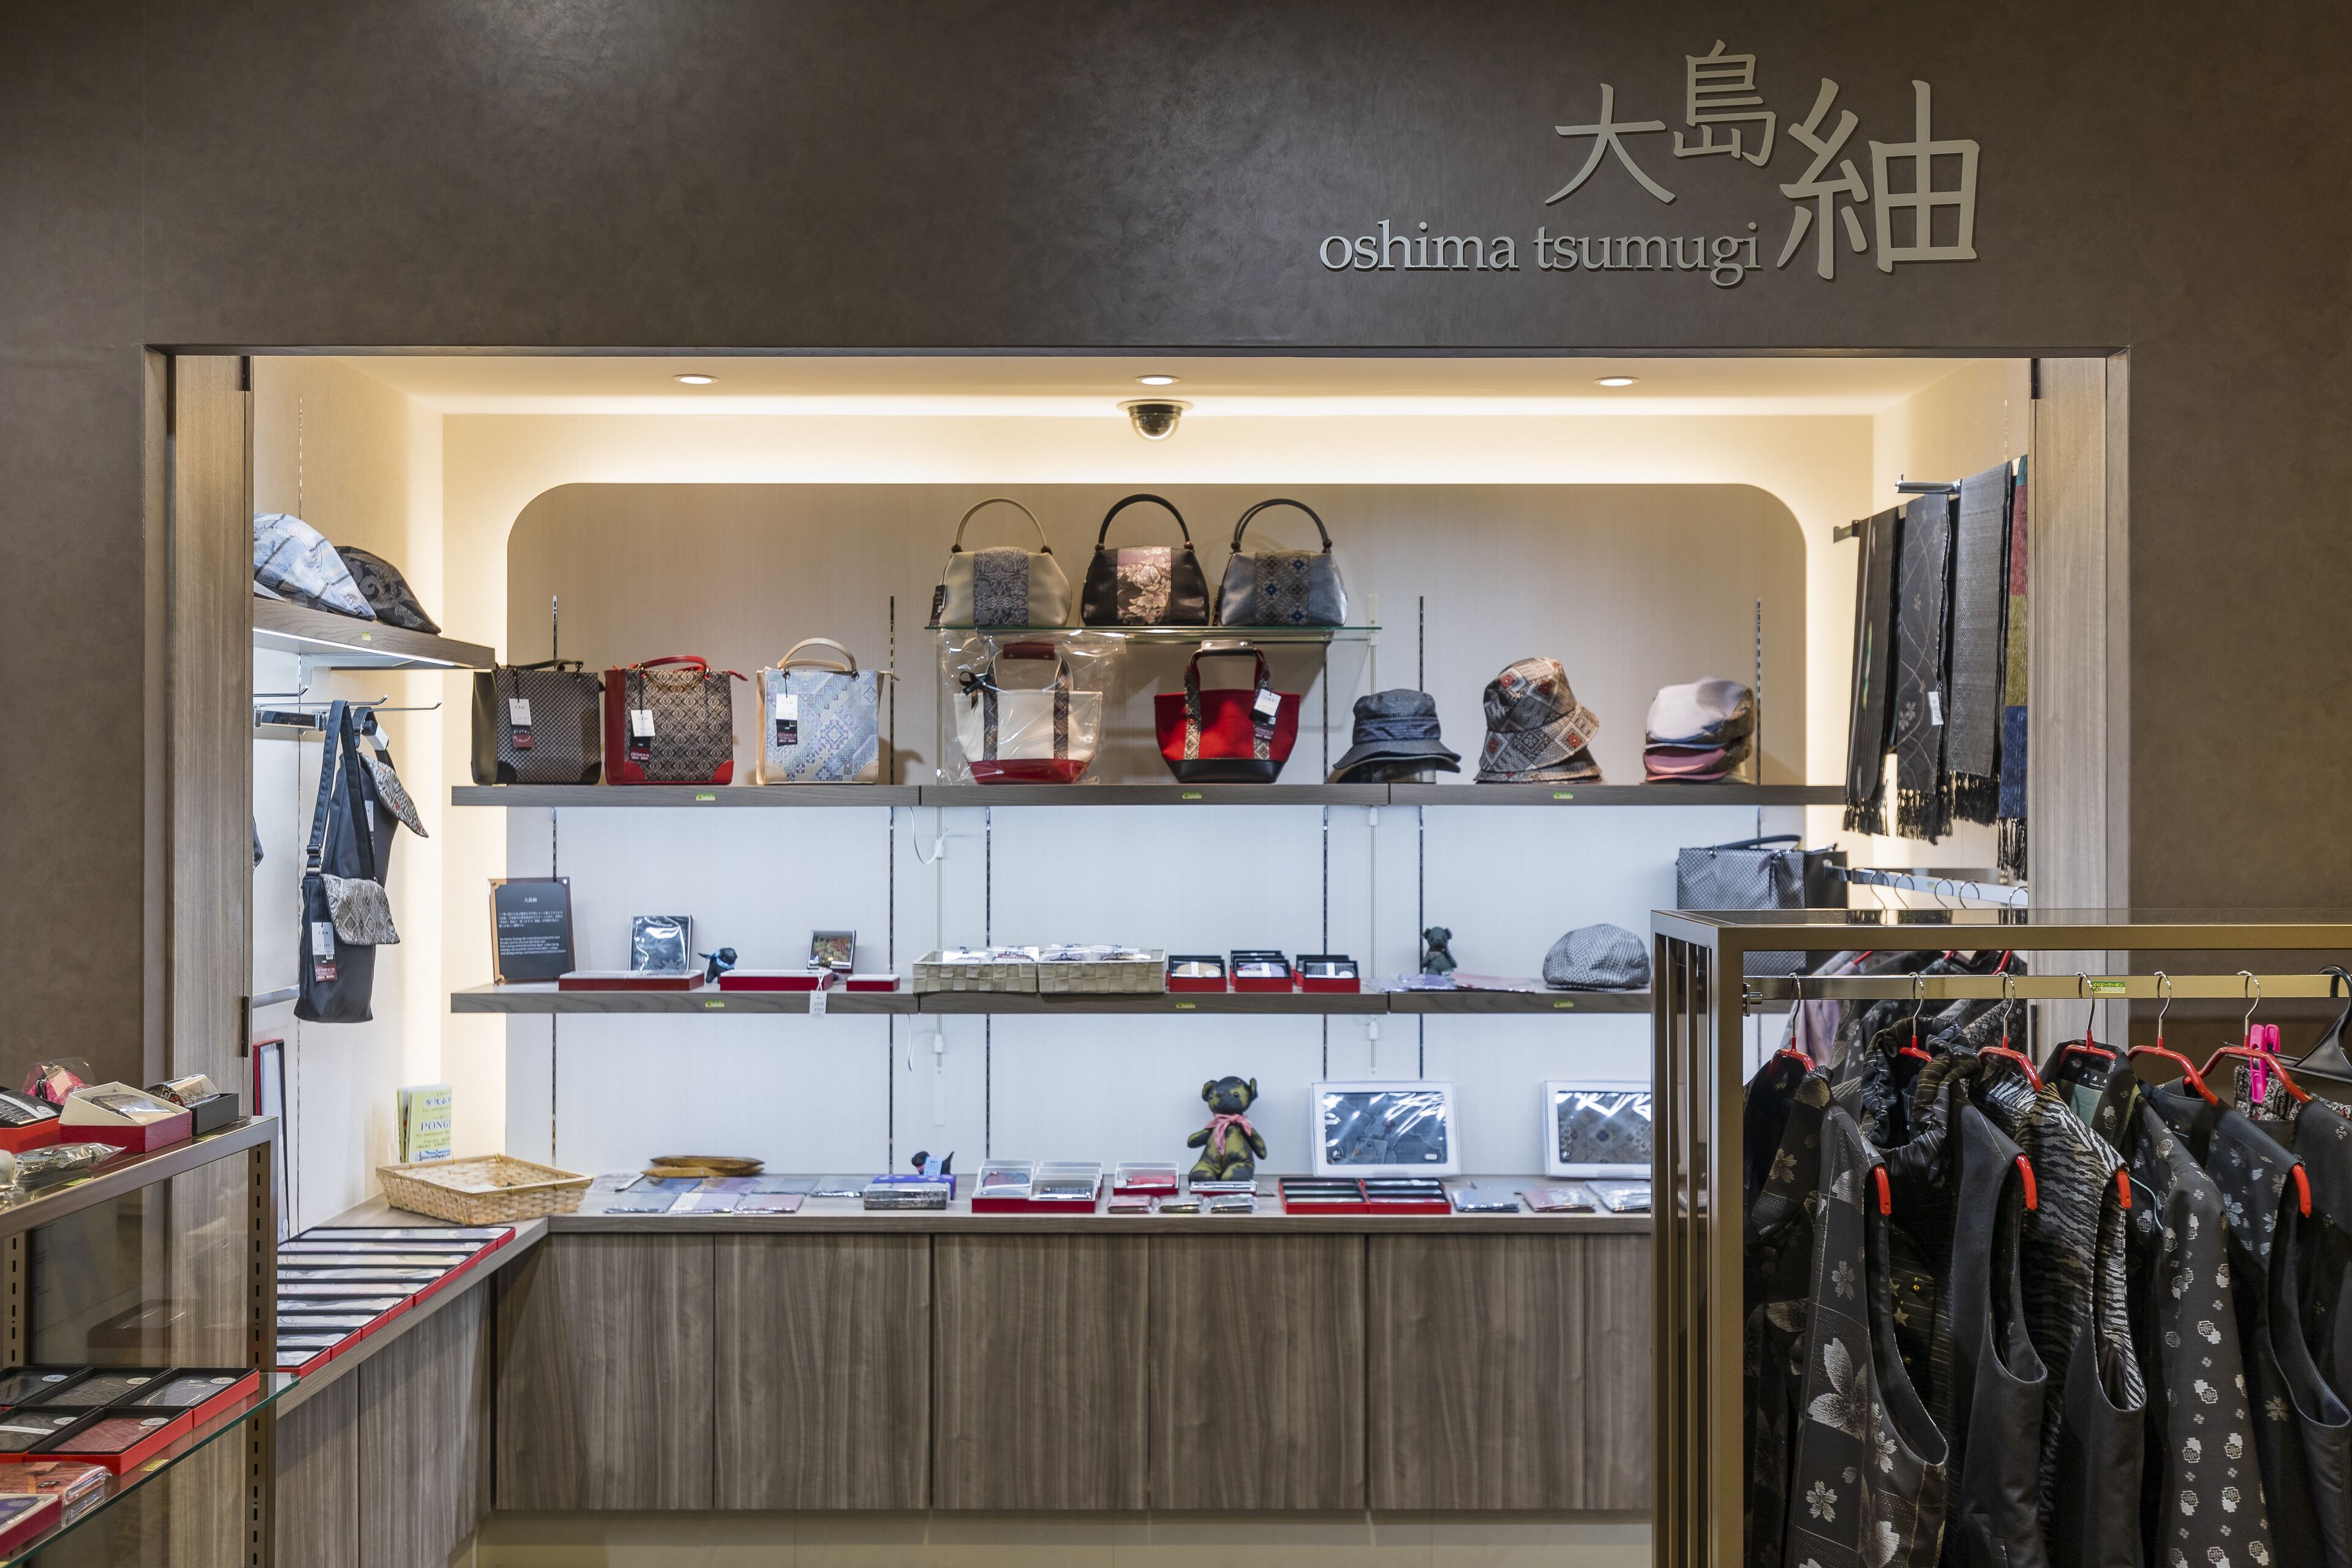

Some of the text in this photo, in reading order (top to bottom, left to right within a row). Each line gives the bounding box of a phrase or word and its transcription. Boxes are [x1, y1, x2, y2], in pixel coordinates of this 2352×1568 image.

[1545, 39, 1981, 281] 大島紬
[1319, 219, 1762, 288] oshima tsumugi
[421, 1120, 451, 1131] PONG
